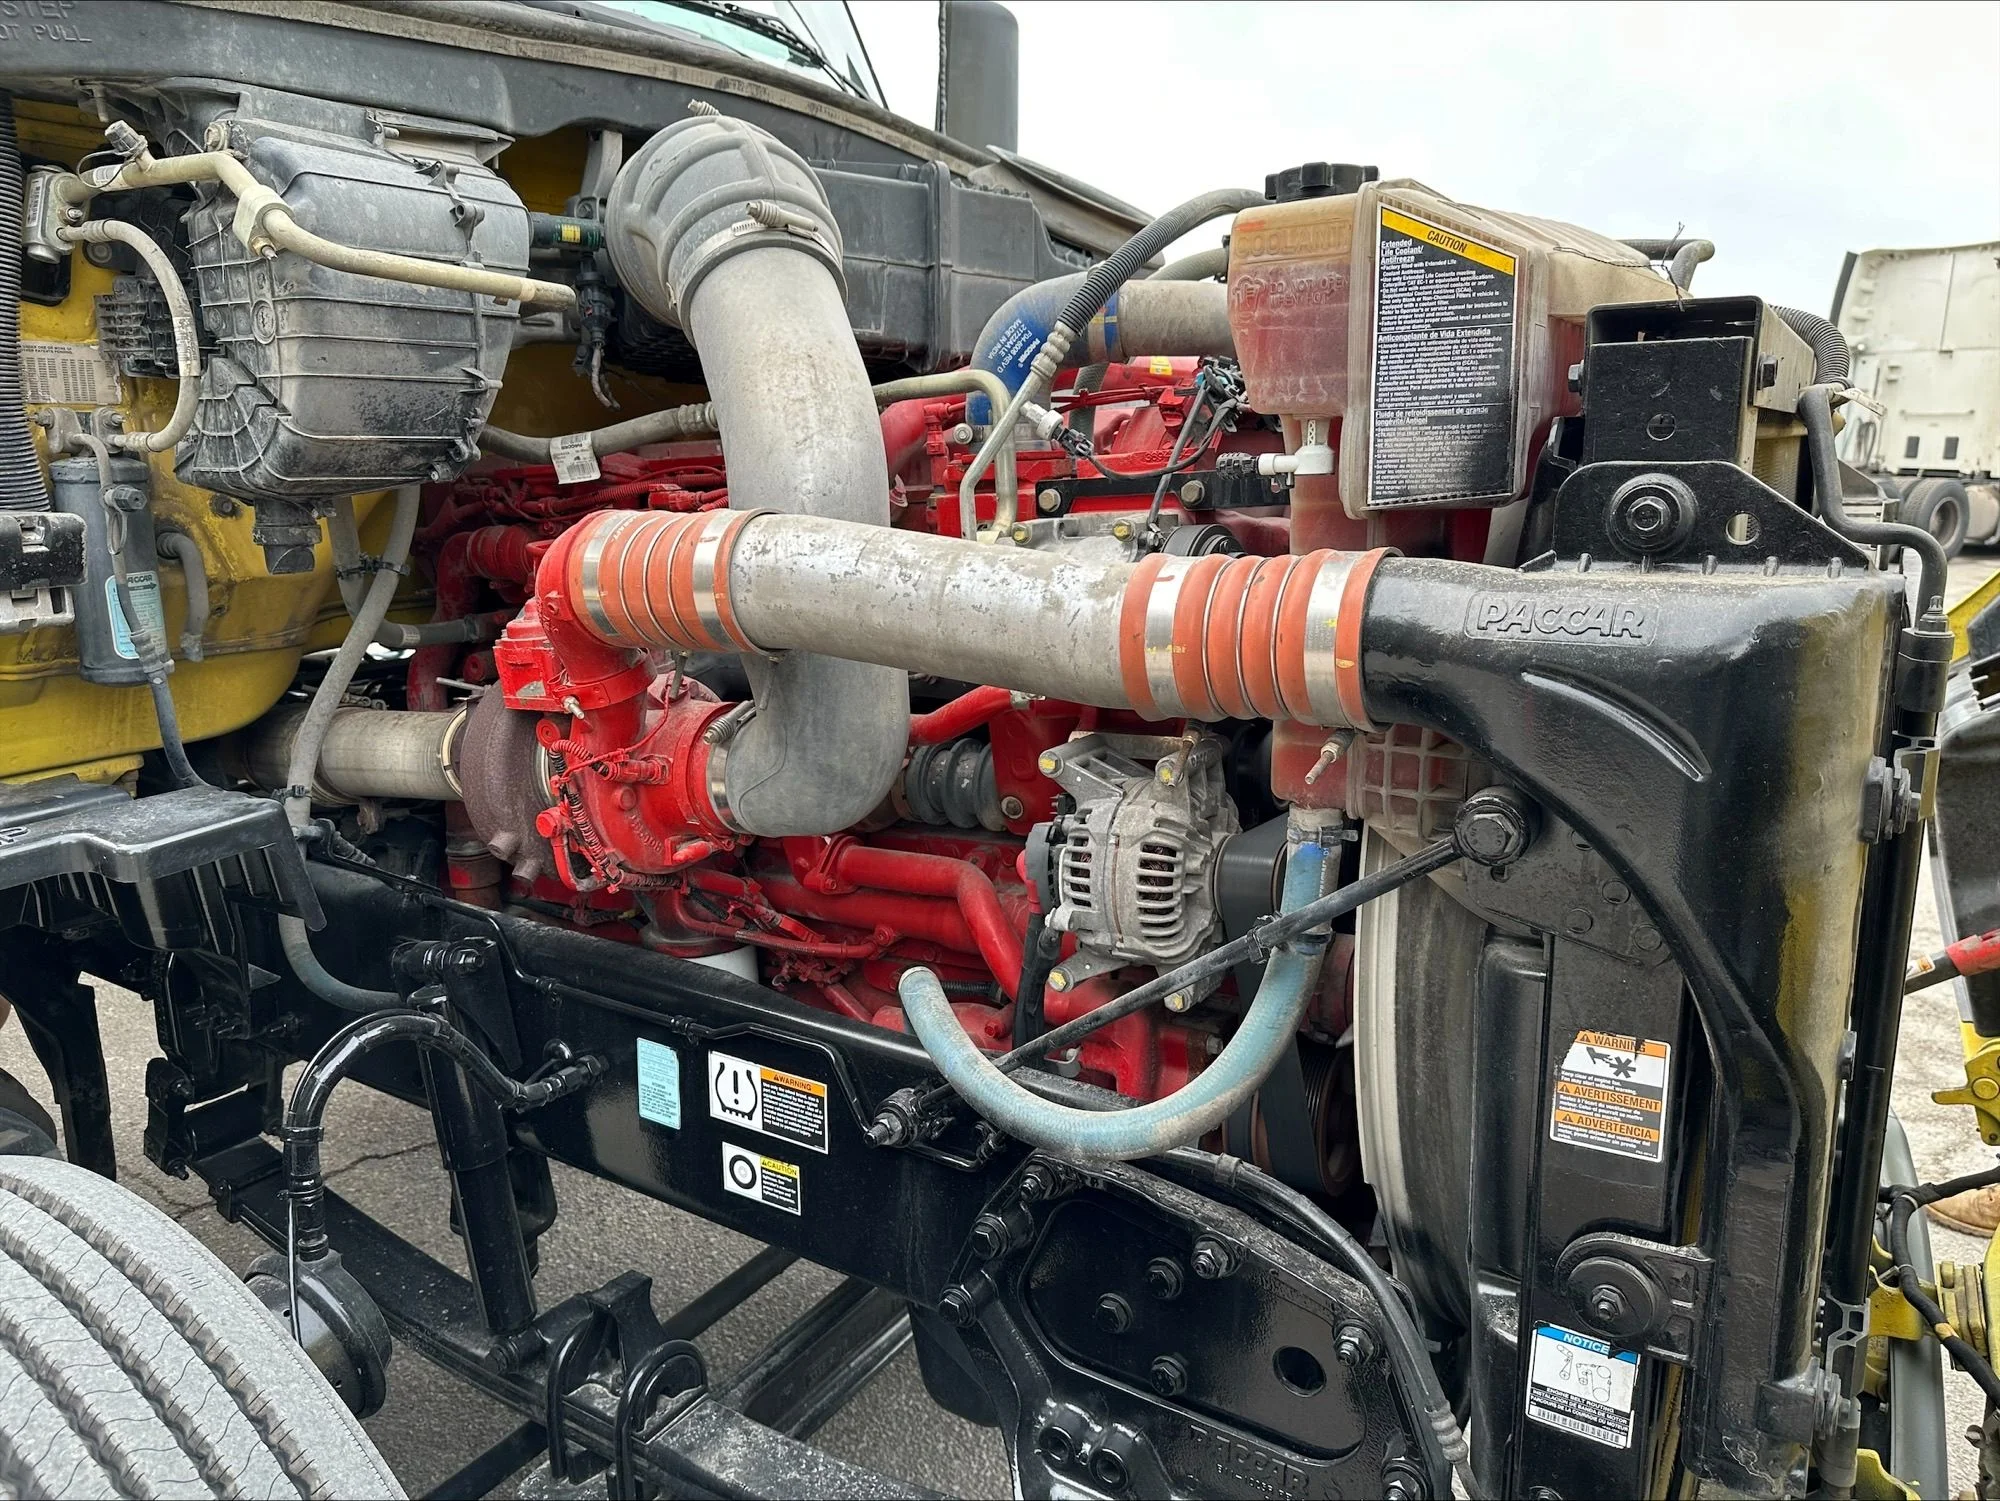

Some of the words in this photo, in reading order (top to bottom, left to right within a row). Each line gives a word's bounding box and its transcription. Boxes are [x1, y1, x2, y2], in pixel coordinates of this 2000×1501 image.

[32, 24, 93, 42] PULL
[1236, 223, 1350, 257] COOLANT
[1381, 239, 1412, 247] Extended
[1427, 230, 1467, 253] CAUTION
[1380, 255, 1414, 264] Antifreeze
[1321, 275, 1349, 291] OPEN
[1004, 318, 1022, 338] MADE
[1378, 331, 1428, 343] Anticongelante
[1429, 330, 1438, 339] de
[1440, 329, 1454, 339] Vida
[1456, 327, 1490, 338] Extendida
[988, 342, 1002, 360] INDIA
[1477, 599, 1646, 639] PACCAR
[779, 1074, 812, 1092] WARNING
[1573, 1085, 1659, 1111] AVERTISSEMENT
[1577, 1114, 1652, 1139] ADVERTENCIA
[767, 1160, 797, 1176] CAUTION
[1563, 1333, 1610, 1355] NOTICE
[1546, 1387, 1569, 1398] ENGINE
[1569, 1395, 1584, 1403] BELT
[1585, 1400, 1614, 1413] ROUTING
[1577, 1404, 1596, 1414] BANDA
[1606, 1414, 1626, 1424] MOTOR
[1606, 1420, 1628, 1431] MOTEUR
